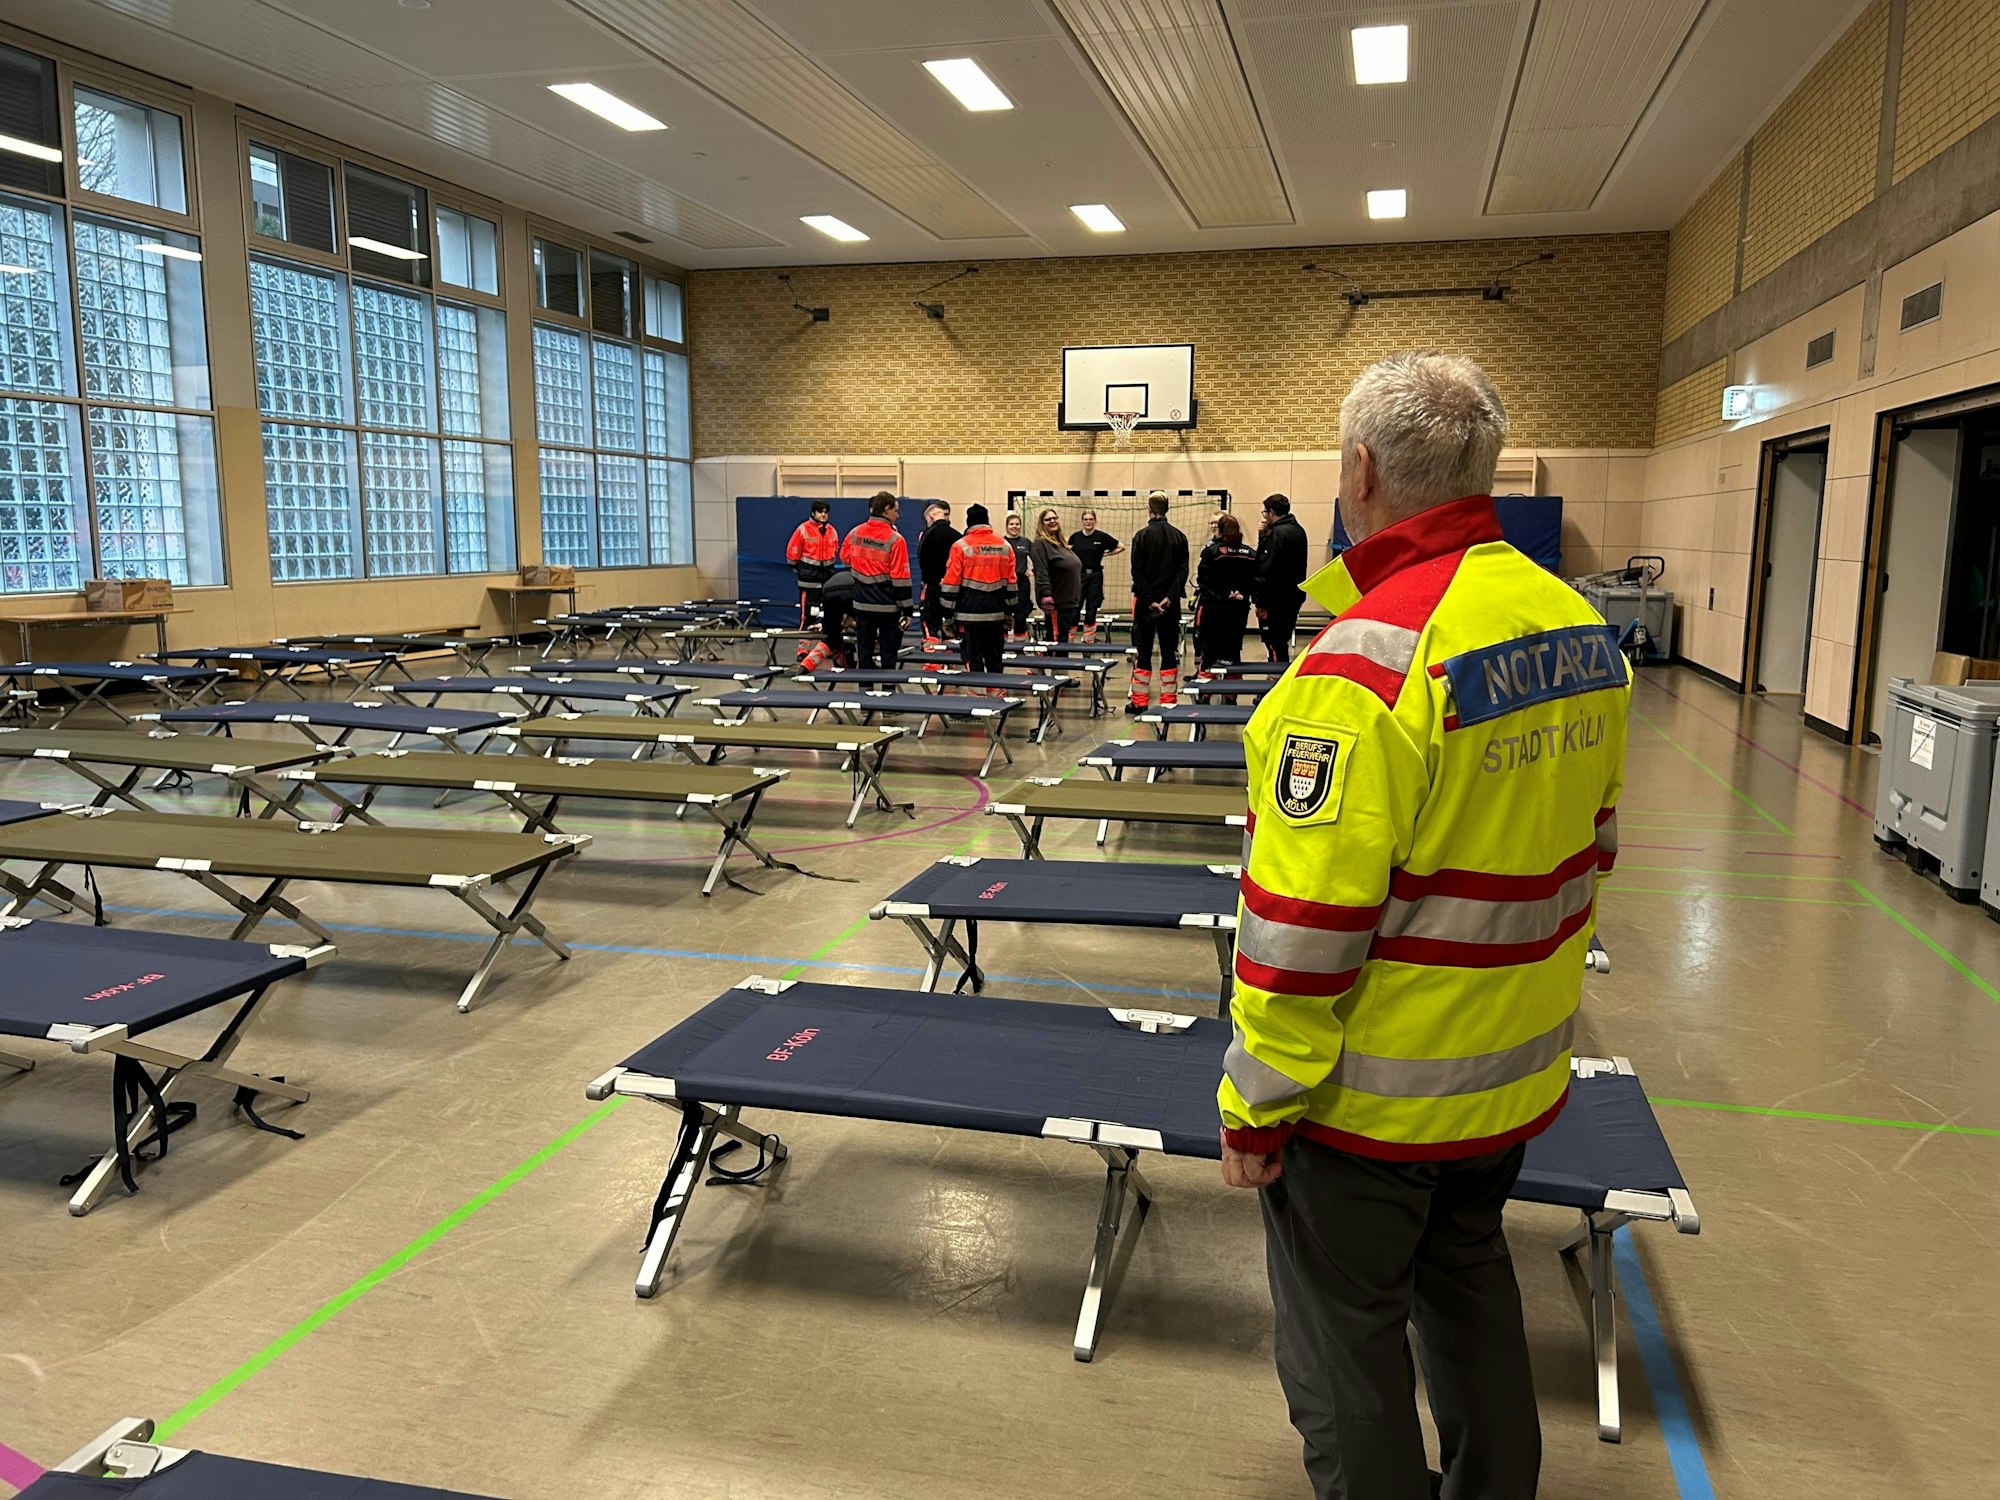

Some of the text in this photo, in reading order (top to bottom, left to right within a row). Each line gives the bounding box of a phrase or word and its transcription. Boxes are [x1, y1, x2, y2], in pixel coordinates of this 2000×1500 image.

[1482, 634, 1617, 705] NOTARZT
[1287, 748, 1330, 762] FEUERWEHR
[1295, 742, 1327, 753] BERUFS-
[1483, 725, 1560, 773] STADT
[1285, 797, 1308, 811] KÖLN
[766, 1028, 820, 1061] BF-Köln
